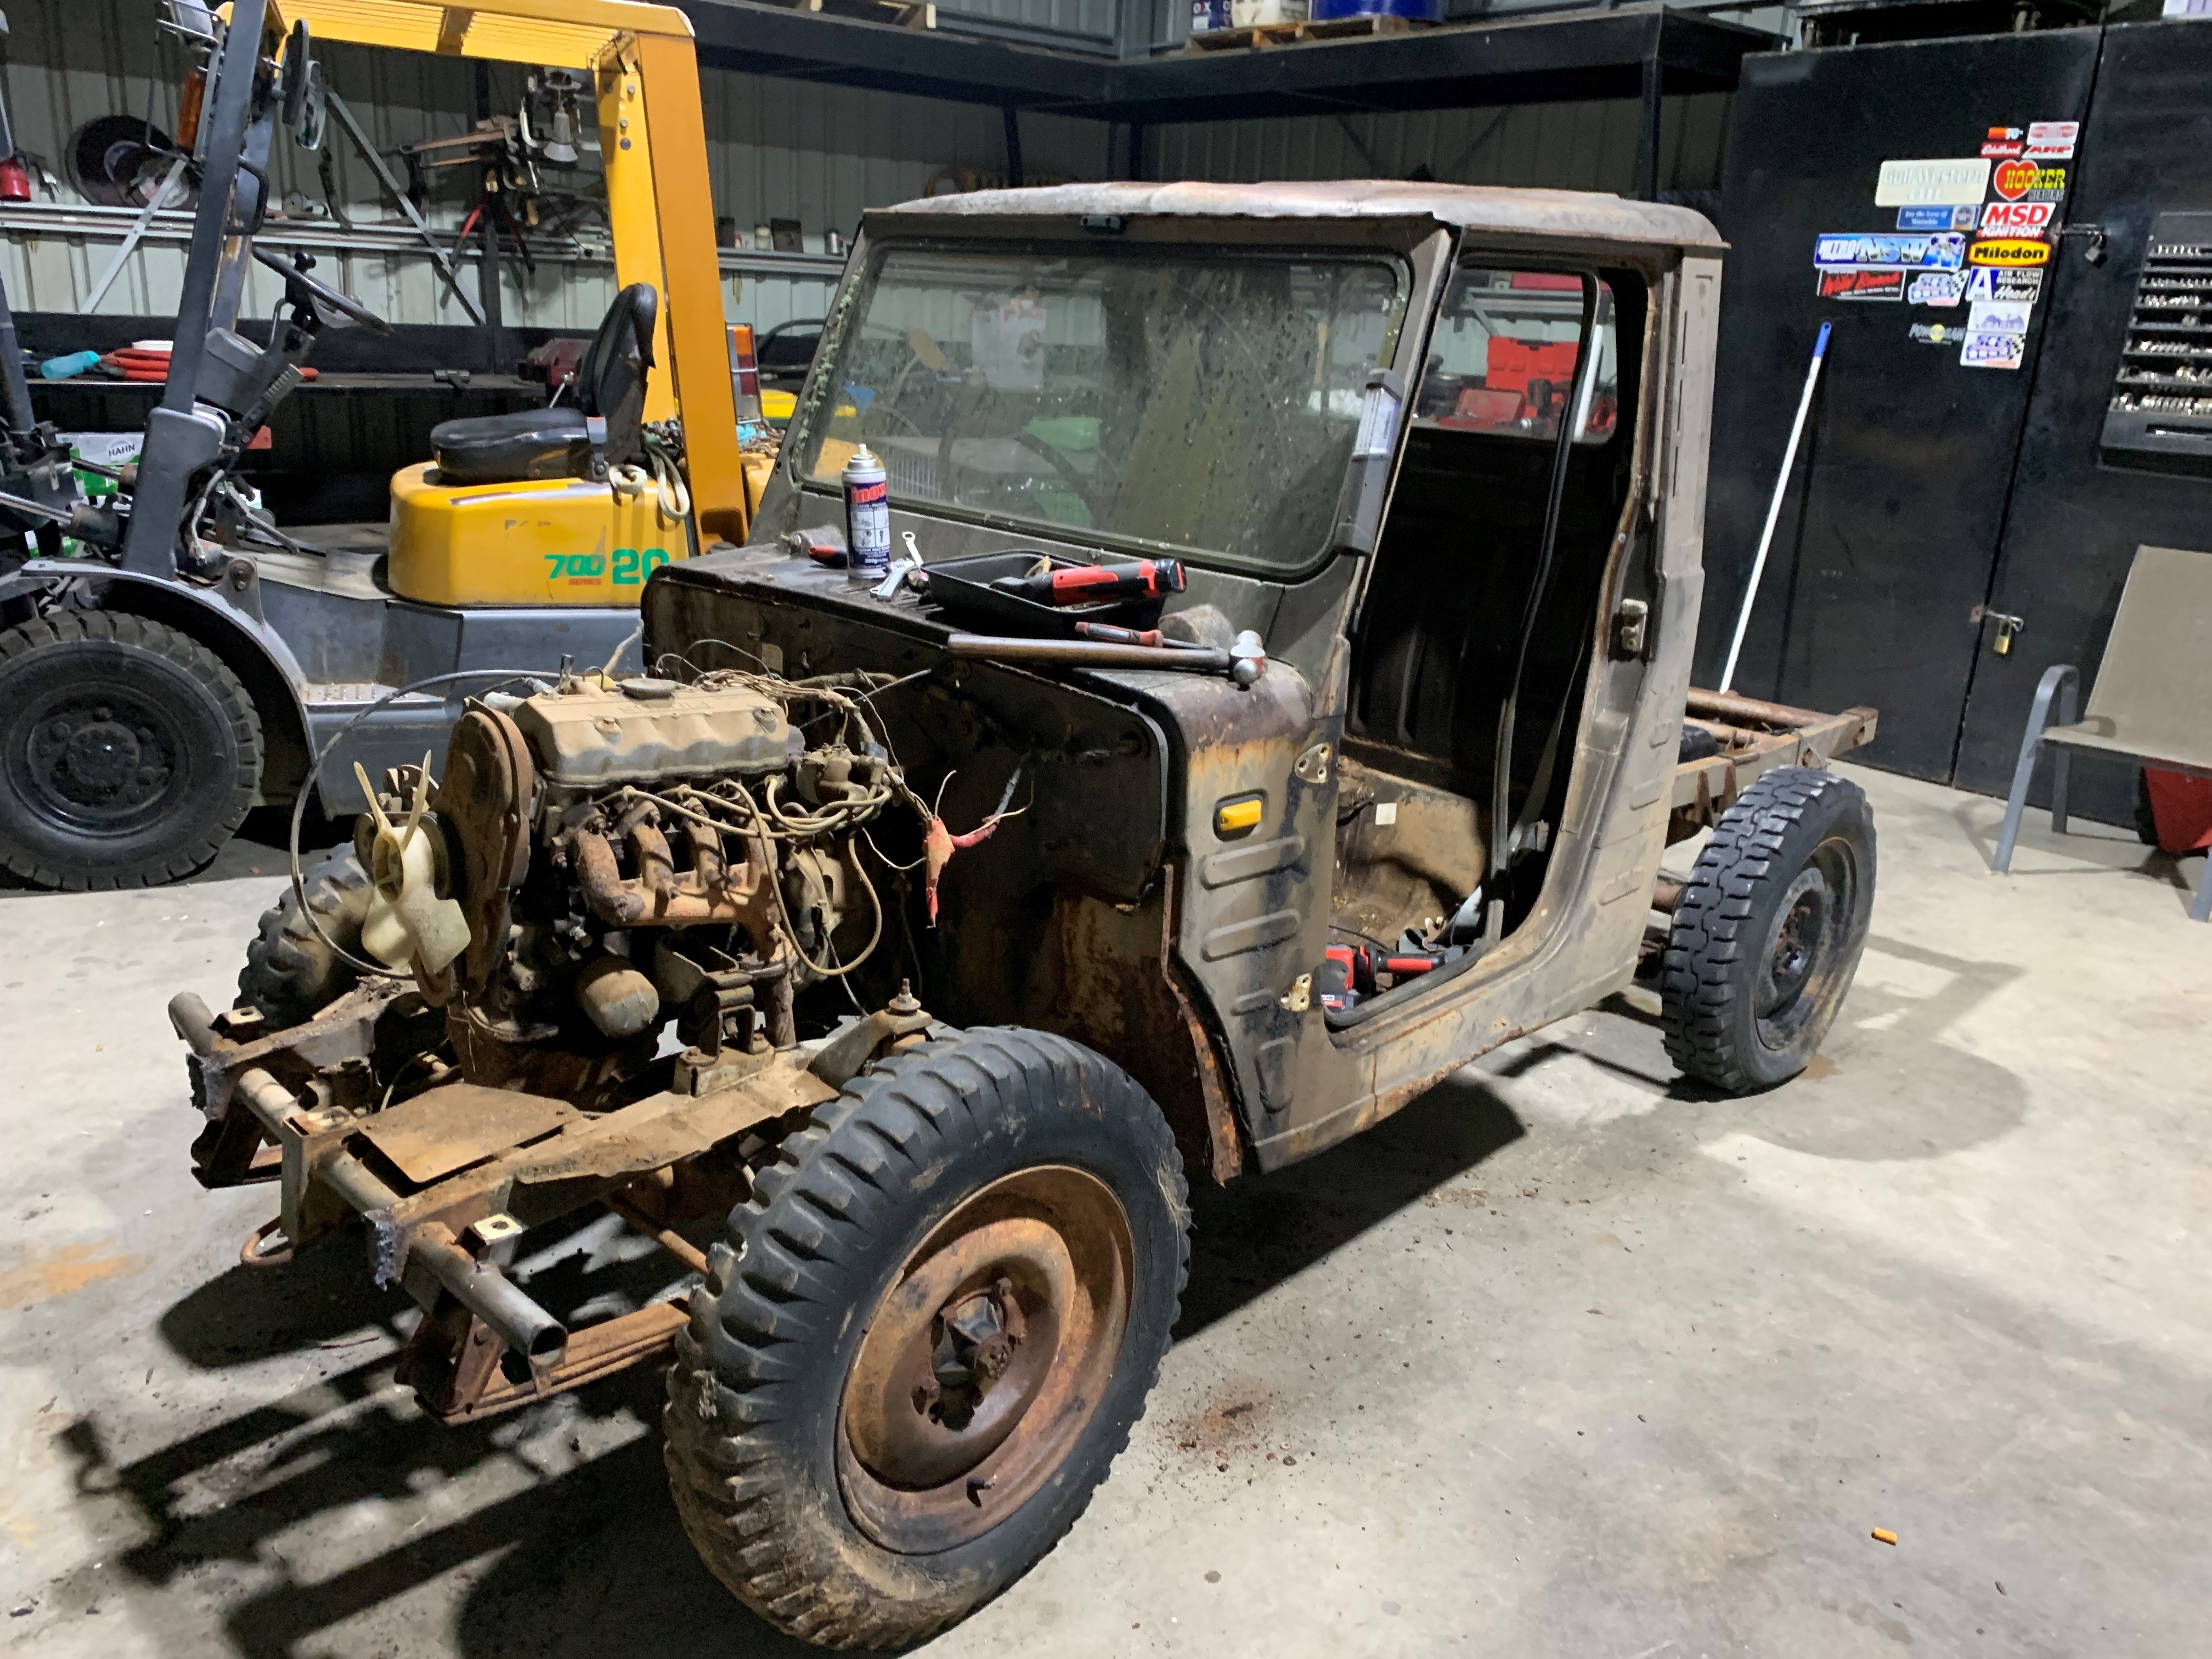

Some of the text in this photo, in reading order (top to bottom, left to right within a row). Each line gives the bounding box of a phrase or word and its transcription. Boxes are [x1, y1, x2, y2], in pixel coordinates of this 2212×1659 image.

[2004, 168, 2066, 189] HOOKER
[1985, 204, 2049, 227] MSD
[1982, 226, 2042, 237] IGNITION
[1974, 246, 2044, 259] Milodon
[109, 443, 135, 456] HAHN
[851, 482, 887, 504] inox
[544, 548, 670, 585] 700 20
